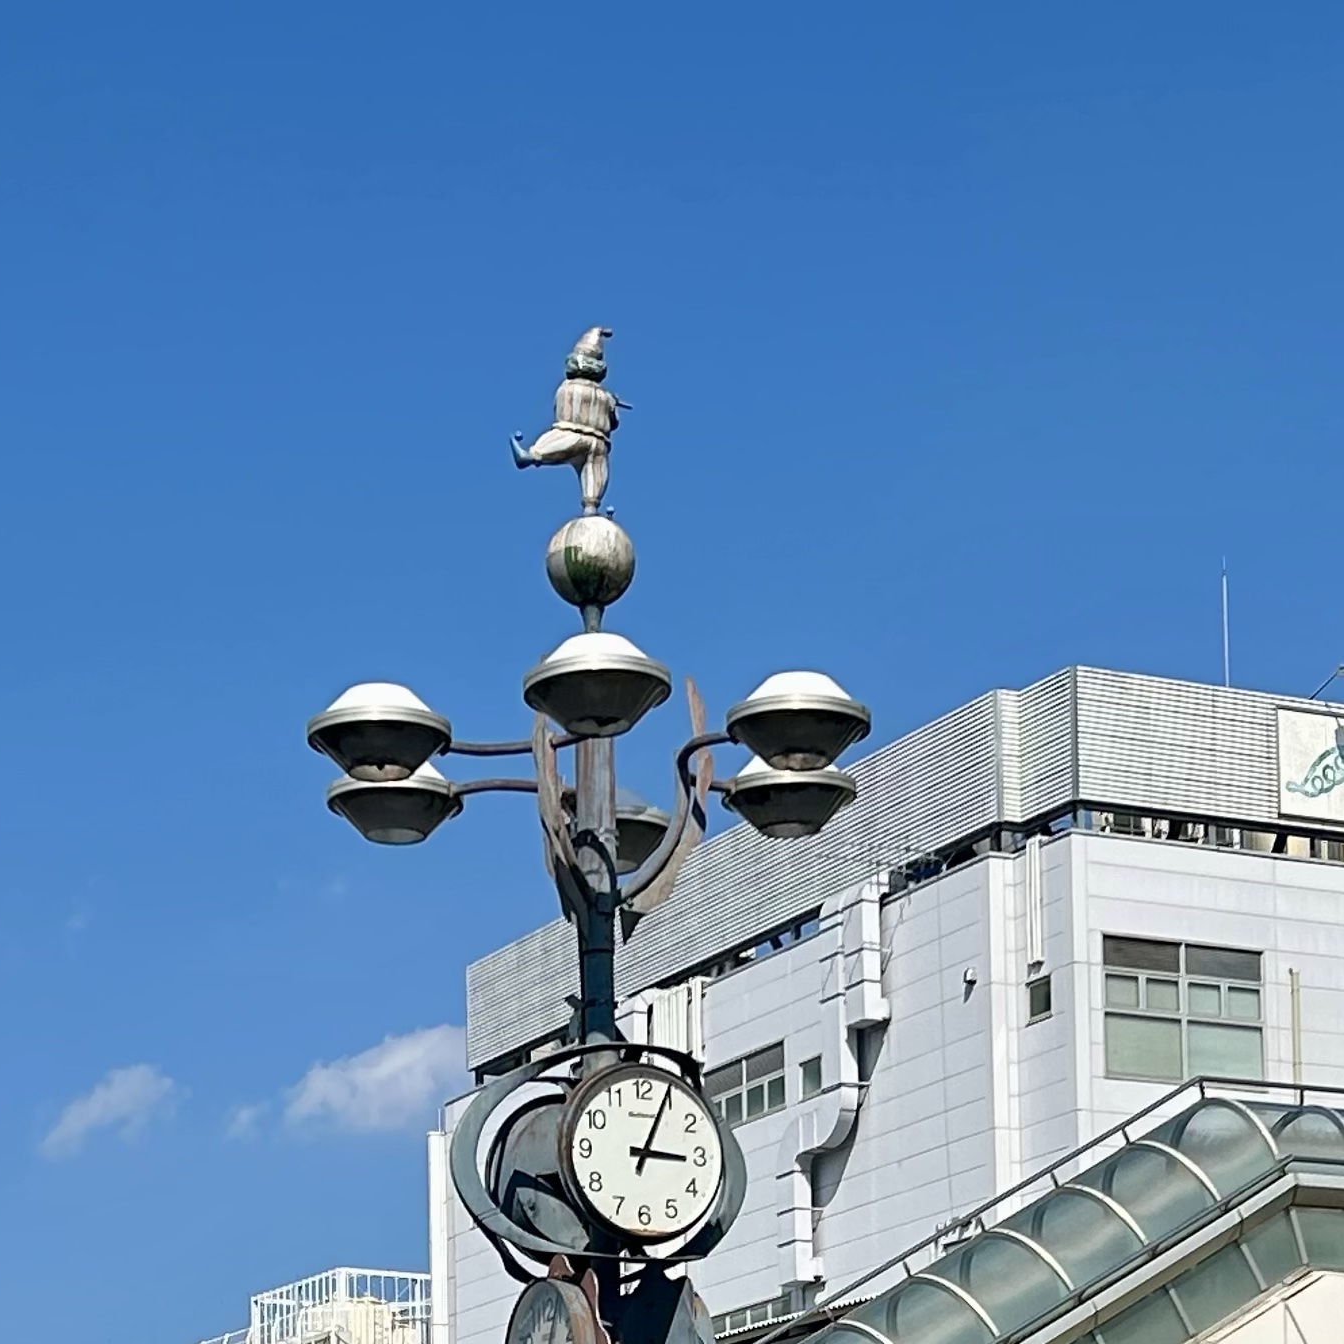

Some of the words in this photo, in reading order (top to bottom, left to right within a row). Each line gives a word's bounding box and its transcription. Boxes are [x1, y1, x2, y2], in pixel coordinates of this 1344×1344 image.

[607, 1087, 622, 1107] 11
[632, 1079, 653, 1101] 12
[585, 1109, 606, 1130] 10
[684, 1113, 697, 1133] 2
[579, 1138, 593, 1159] 9
[693, 1146, 707, 1167] 3
[588, 1171, 603, 1192] 8
[685, 1177, 698, 1198] 4
[612, 1195, 626, 1216] 7
[638, 1204, 651, 1226] 6
[664, 1198, 678, 1219] 5
